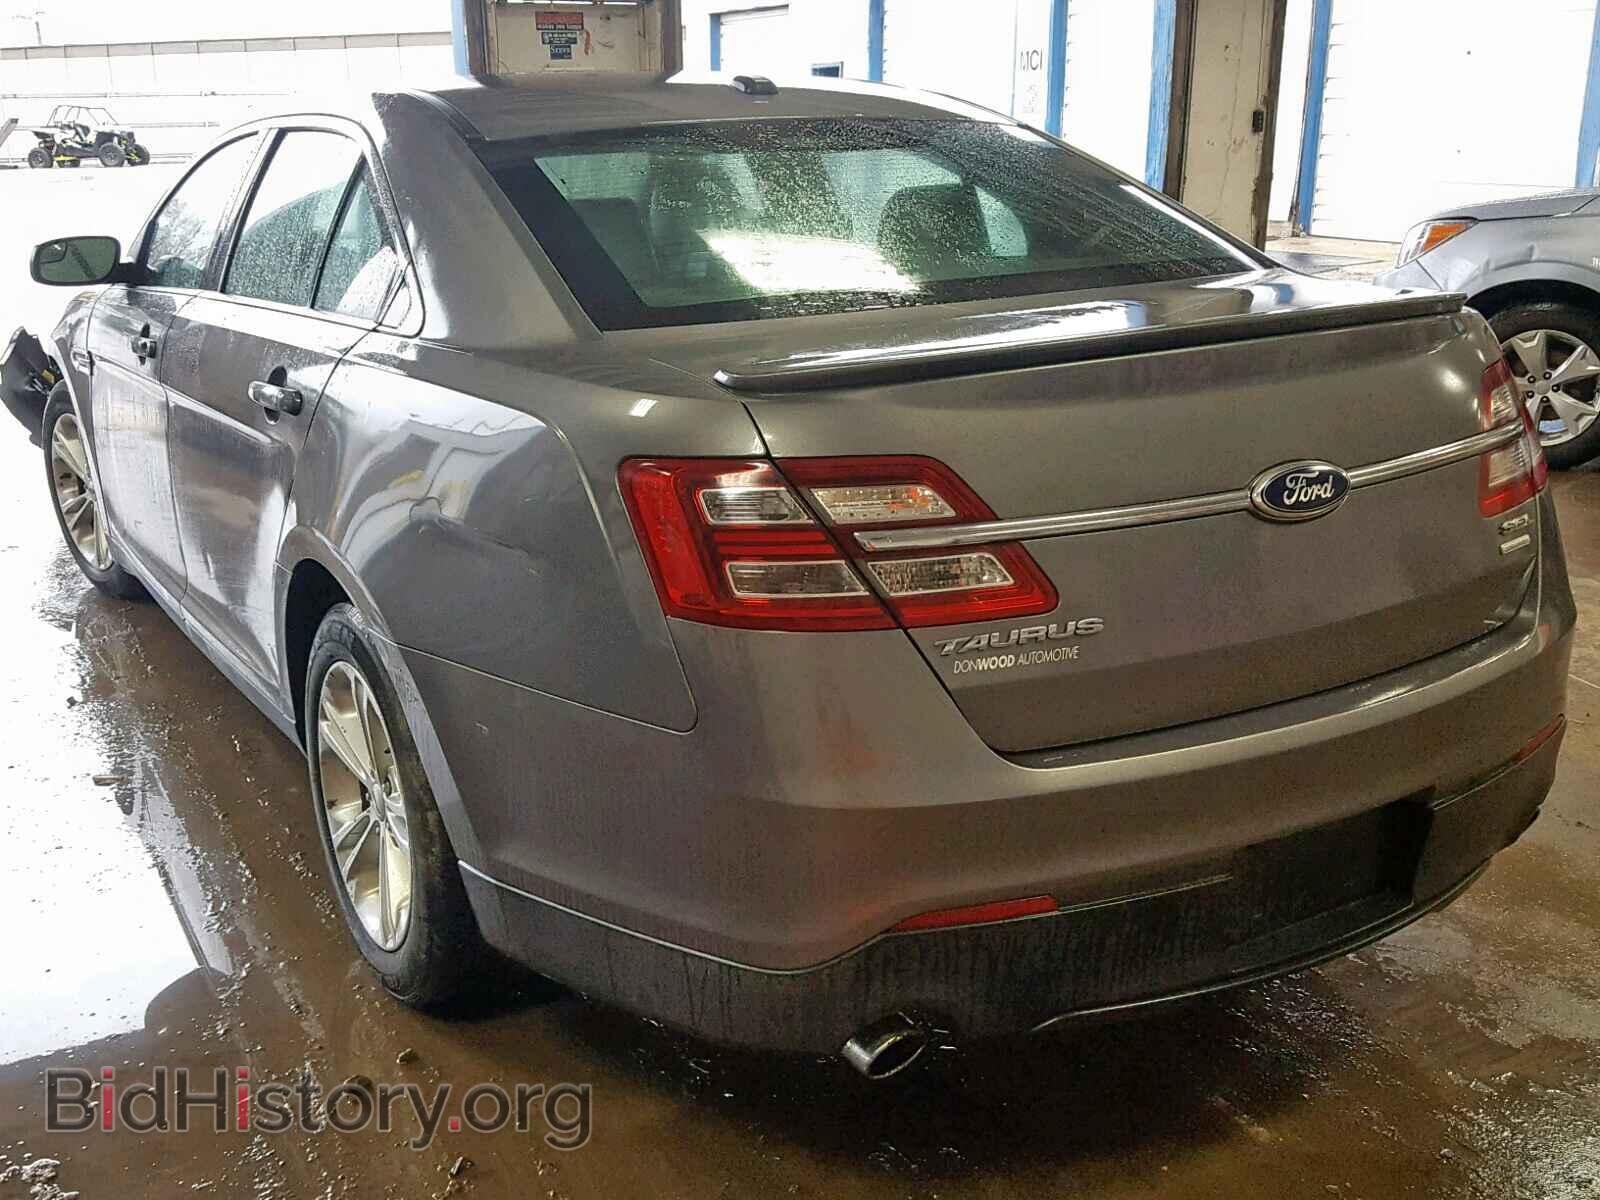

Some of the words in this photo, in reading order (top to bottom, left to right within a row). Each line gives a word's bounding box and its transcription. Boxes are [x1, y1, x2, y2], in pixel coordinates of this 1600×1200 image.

[1283, 470, 1334, 505] Ford
[934, 617, 1105, 656] TAURUS
[953, 655, 1016, 674] DONWOOD
[1018, 645, 1081, 666] AUTOMOTIVE
